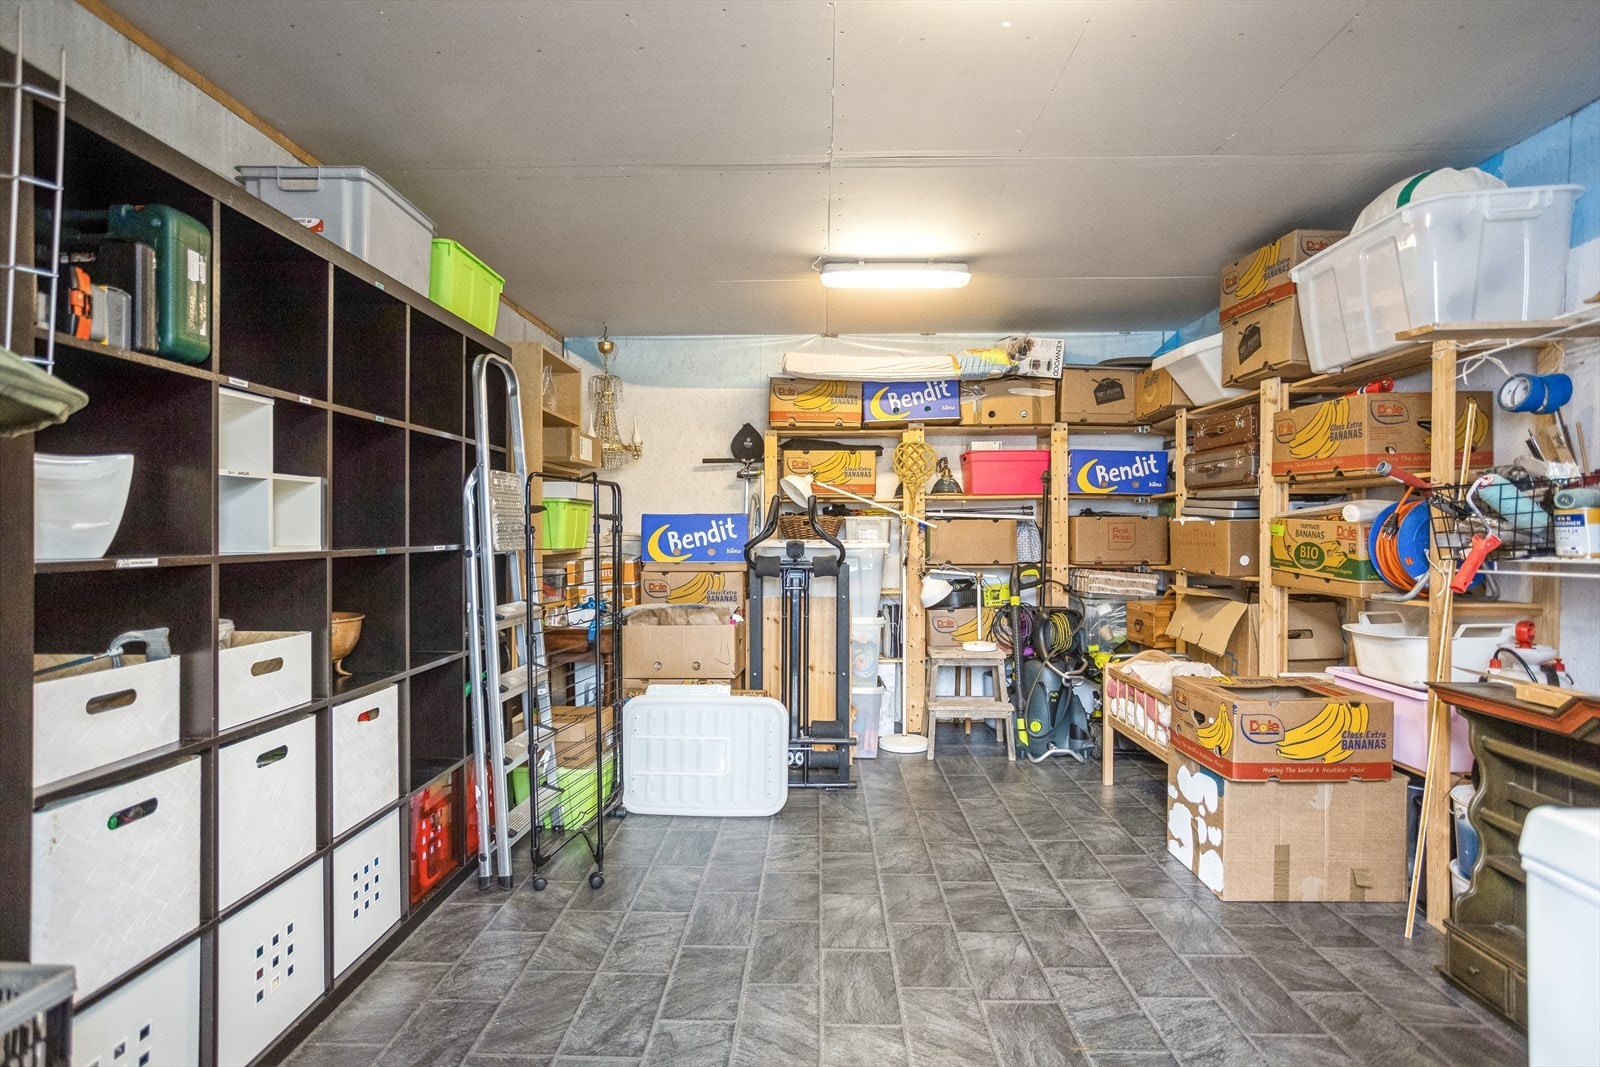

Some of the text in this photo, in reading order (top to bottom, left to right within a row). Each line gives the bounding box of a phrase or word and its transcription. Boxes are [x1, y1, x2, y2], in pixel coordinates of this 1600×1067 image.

[1052, 340, 1063, 377] KENWOOD
[887, 381, 951, 412] Bendit
[1377, 404, 1403, 414] Dole
[1345, 421, 1363, 429] Extra
[1329, 428, 1363, 441] BANANAS
[791, 460, 809, 468] Dole
[1095, 454, 1159, 486] Bendit
[667, 517, 738, 554] Bendit
[1295, 529, 1325, 540] BANANAS
[1336, 525, 1358, 539] Dole
[1300, 546, 1319, 560] BIO
[649, 583, 668, 591] Dole
[1249, 719, 1280, 732] Dole
[1341, 730, 1386, 739] Class Extra
[1341, 738, 1387, 750] BANANAS
